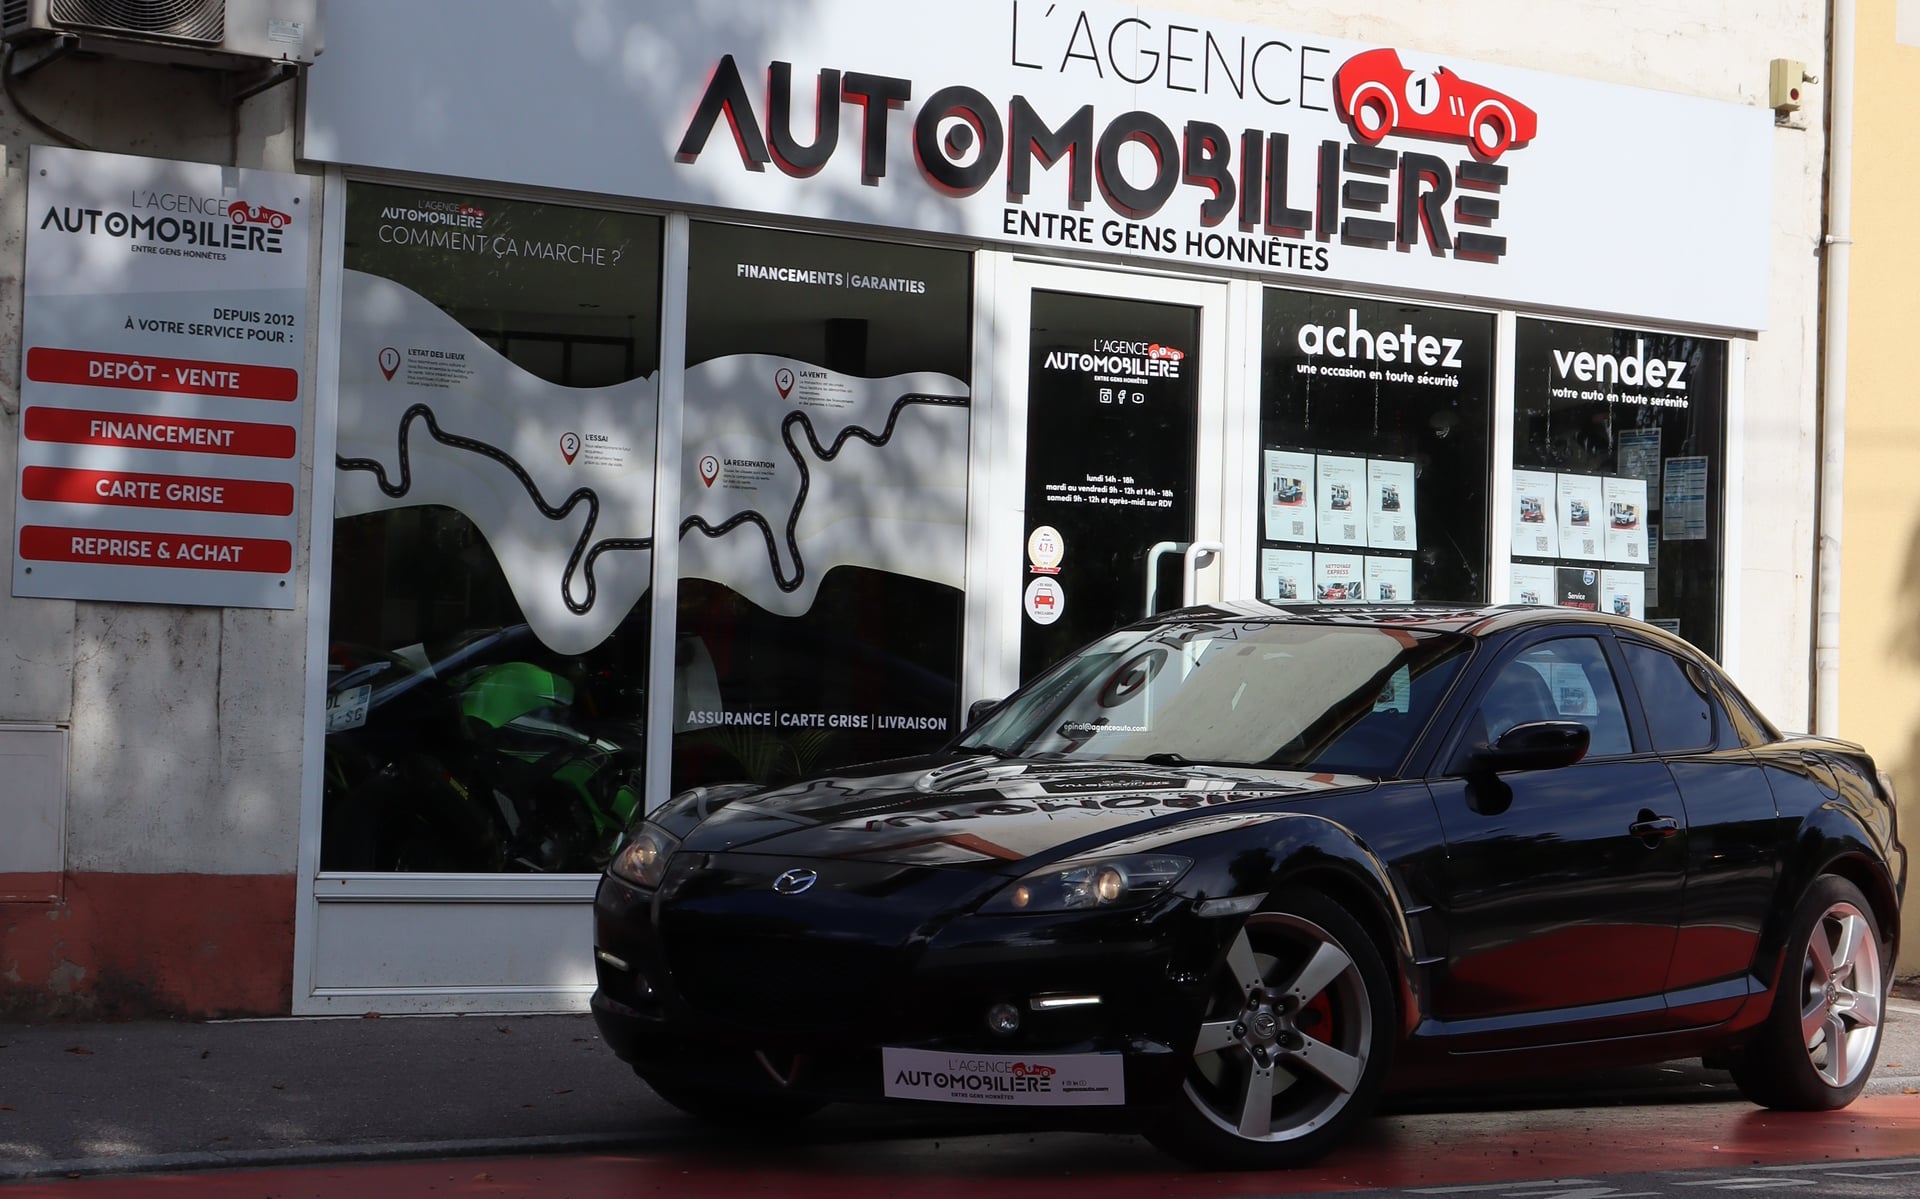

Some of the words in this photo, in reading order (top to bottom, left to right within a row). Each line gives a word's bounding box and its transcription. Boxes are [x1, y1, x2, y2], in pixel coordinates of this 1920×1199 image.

[1012, 0, 1331, 111] L'AGENCE
[132, 189, 228, 217] L'AGENCE
[418, 199, 460, 213] L'AGENCE
[378, 224, 488, 253] COMMENT
[492, 237, 518, 259] ÇA
[523, 240, 606, 266] MARCHE
[611, 249, 621, 266] ?
[1003, 209, 1094, 243] ENTRE
[1101, 219, 1177, 253] GENS
[1185, 236, 1329, 272] HONNÊTES
[131, 244, 157, 254] ENTRE
[159, 247, 181, 257] GENS
[182, 250, 227, 261] HONNÊTES
[737, 263, 843, 286] FINANCEMENTS
[850, 273, 926, 294] GARANTIES
[213, 307, 261, 323] DEPUIS
[264, 312, 295, 327] 2012
[124, 315, 135, 329] À
[138, 318, 185, 334] VOTRE
[188, 323, 244, 340] SERVICE
[247, 329, 285, 343] POUR
[1297, 308, 1464, 369] achetez
[430, 350, 444, 359] DES
[445, 352, 465, 360] LIEUX
[1093, 339, 1149, 356] L'AGENCE
[88, 359, 157, 382] DEPÔT
[175, 367, 240, 389] VENTE
[1552, 338, 1688, 390] vendez
[808, 371, 828, 379] VENTE
[1296, 364, 1317, 374] une
[1320, 365, 1366, 379] occasion
[1369, 370, 1383, 380] en
[1385, 369, 1414, 383] toute
[1417, 371, 1459, 388] sécurité
[1552, 387, 1578, 399] votre
[1581, 390, 1604, 401] auto
[1606, 393, 1619, 403] en
[1621, 392, 1648, 405] toute
[1650, 394, 1689, 408] serénité
[90, 420, 235, 448] FINANCEMENT
[732, 459, 775, 469] RESERVATION
[1086, 474, 1104, 482] lundi
[1105, 475, 1116, 483] 14h
[1122, 476, 1134, 484] 18h
[95, 478, 161, 500] CARTE
[166, 483, 225, 504] GRISE
[1046, 483, 1066, 491] mardi
[1078, 484, 1108, 493] vendredi
[1109, 486, 1118, 494] 9h
[1124, 487, 1135, 495] 12h
[1144, 488, 1156, 496] 14h
[1162, 489, 1174, 497] 18h
[1047, 494, 1072, 502] samedi
[1073, 494, 1083, 502] 9h
[1088, 496, 1100, 504] 12h
[1101, 496, 1108, 504] et
[1146, 499, 1157, 507] sur
[1158, 499, 1173, 508] RDV
[71, 536, 152, 558] REPRISE
[157, 541, 170, 559] &
[175, 543, 243, 563] ACHAT
[1567, 591, 1585, 600] Service
[687, 710, 771, 726] ASSURANCE
[780, 713, 825, 727] CARTE
[828, 714, 868, 728] GRISE
[877, 715, 947, 731] LIVRAISON
[948, 1059, 1013, 1074] L'AGENCE
